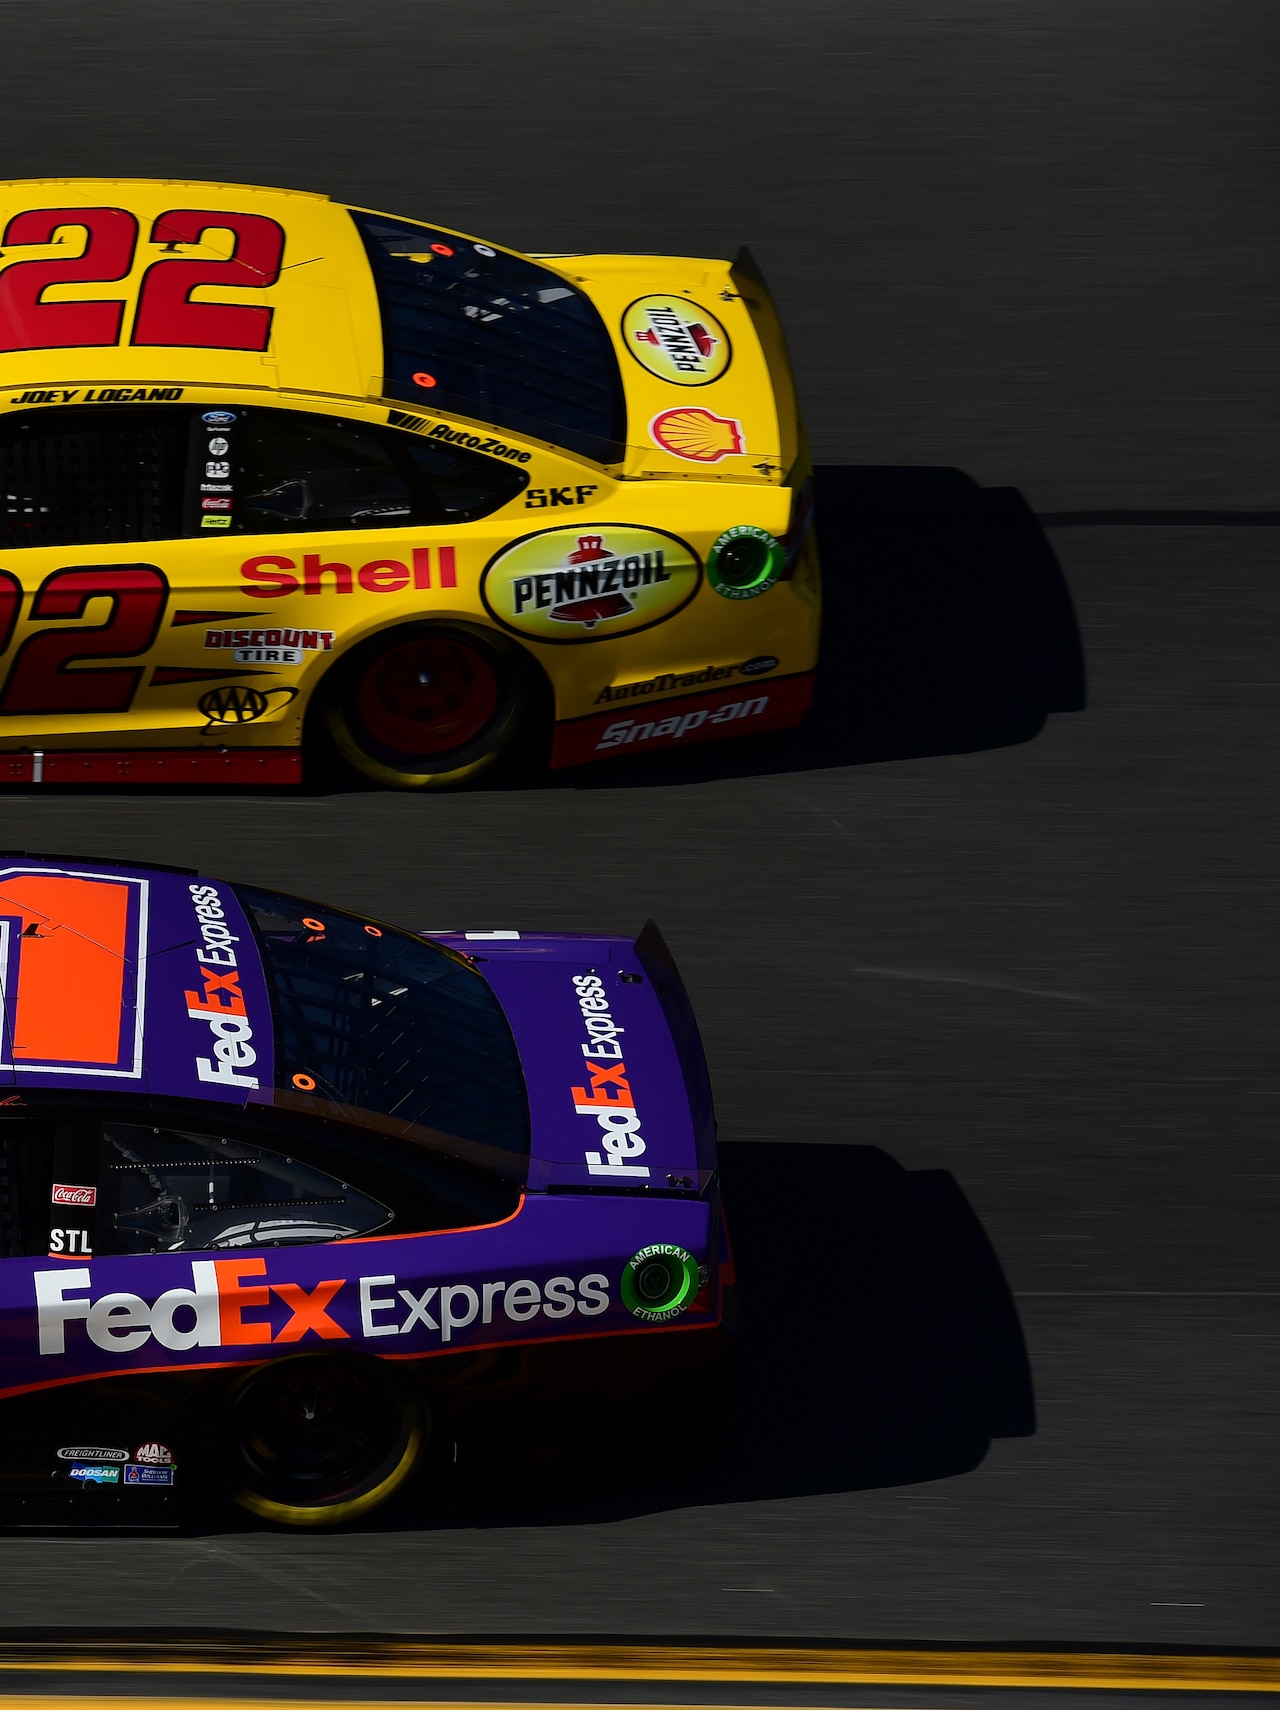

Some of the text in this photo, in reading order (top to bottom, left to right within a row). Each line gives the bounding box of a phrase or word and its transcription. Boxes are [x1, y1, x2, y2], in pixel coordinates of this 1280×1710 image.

[646, 306, 707, 374] PENNZOIL
[10, 387, 185, 404] JOEY LOGANO
[427, 423, 532, 465] AutoZone
[524, 484, 598, 508] SKF
[239, 546, 457, 598] Shell
[713, 525, 777, 600] AMERICAN ETHANOL
[510, 550, 672, 616] PENNZOIL
[203, 628, 335, 651] DISCOUNT
[239, 649, 296, 662] TIRE
[204, 686, 262, 723] AAA
[594, 696, 770, 750] Snap-on
[184, 884, 260, 1090] FedEx Express
[570, 974, 651, 1177] FedEx Express
[49, 1228, 93, 1253] STL
[629, 1244, 690, 1322] AMERICAN ETHANOL
[34, 1257, 611, 1355] FedEx Express
[63, 1448, 124, 1459] FREIGHTLINER
[136, 1443, 172, 1457] MAC
[137, 1456, 172, 1464] TOOLS
[69, 1467, 119, 1477] DOOSAN
